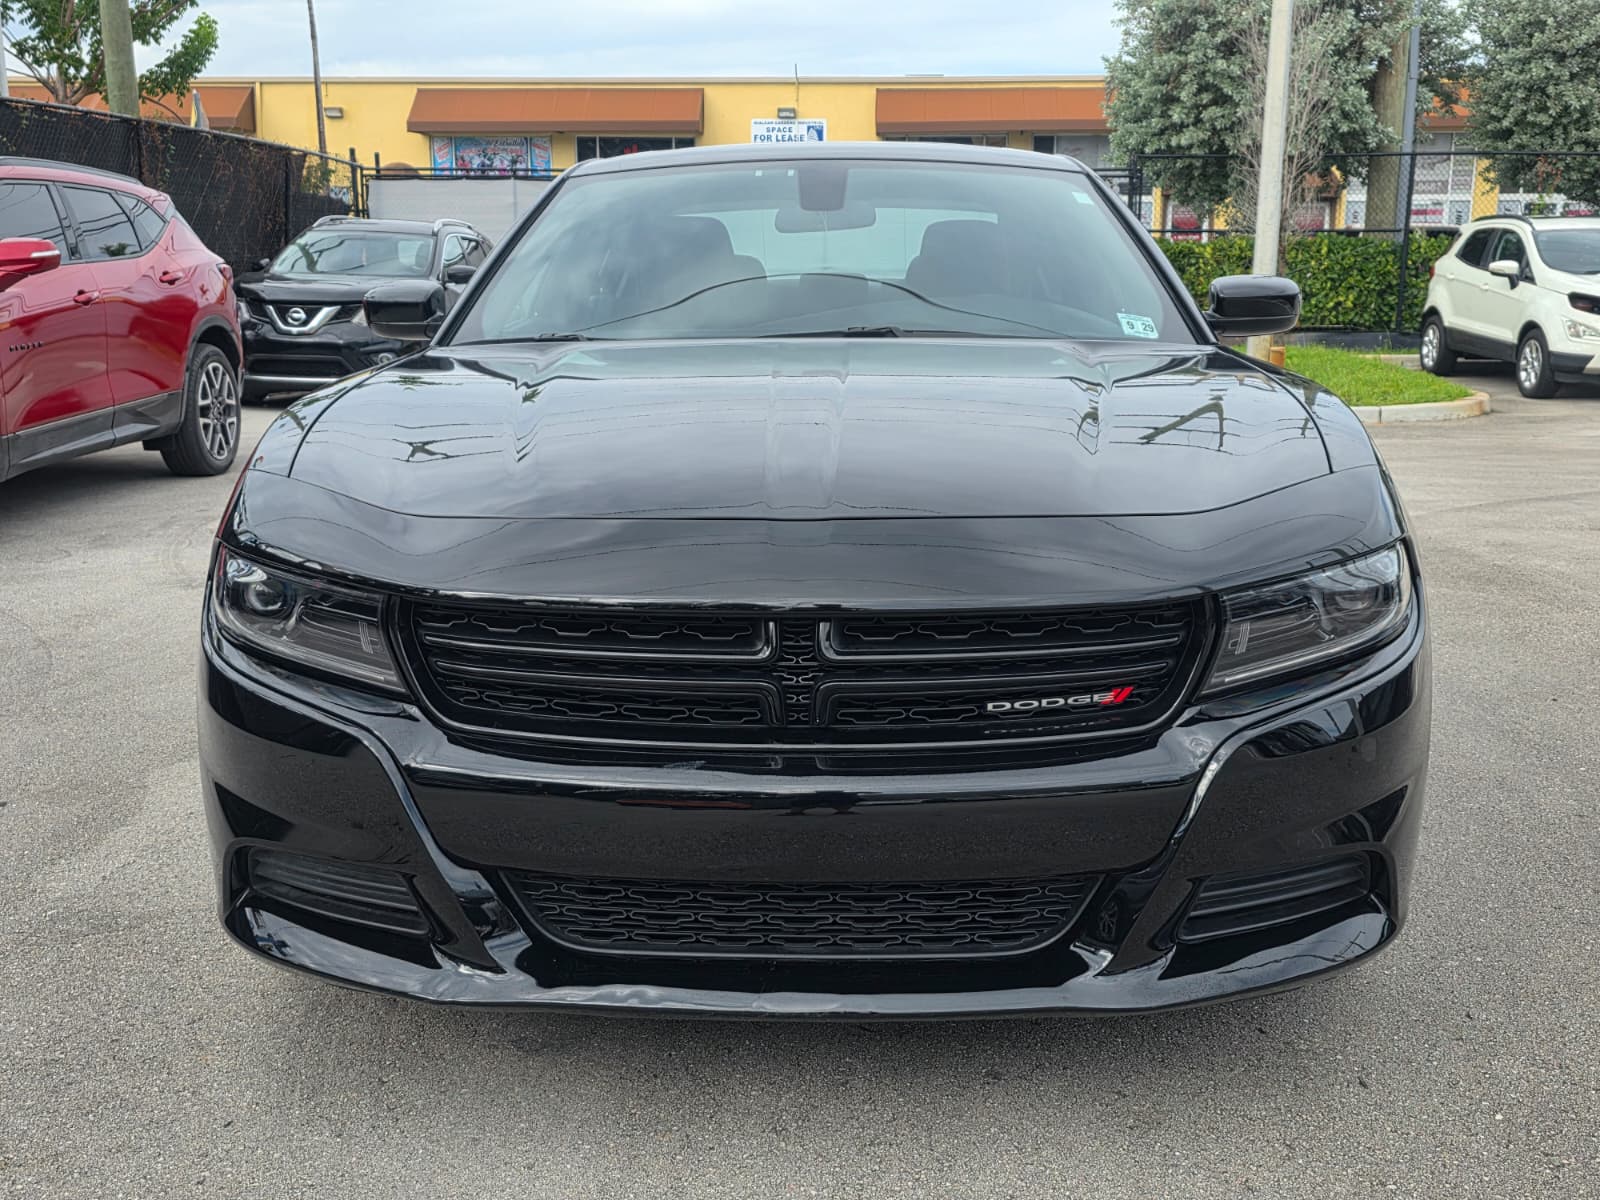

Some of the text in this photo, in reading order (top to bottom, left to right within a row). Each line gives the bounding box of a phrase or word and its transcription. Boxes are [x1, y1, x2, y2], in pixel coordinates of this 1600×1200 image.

[753, 134, 805, 142] FOR LEASE
[1126, 320, 1155, 332] 9 29
[986, 691, 1114, 712] DODGE
